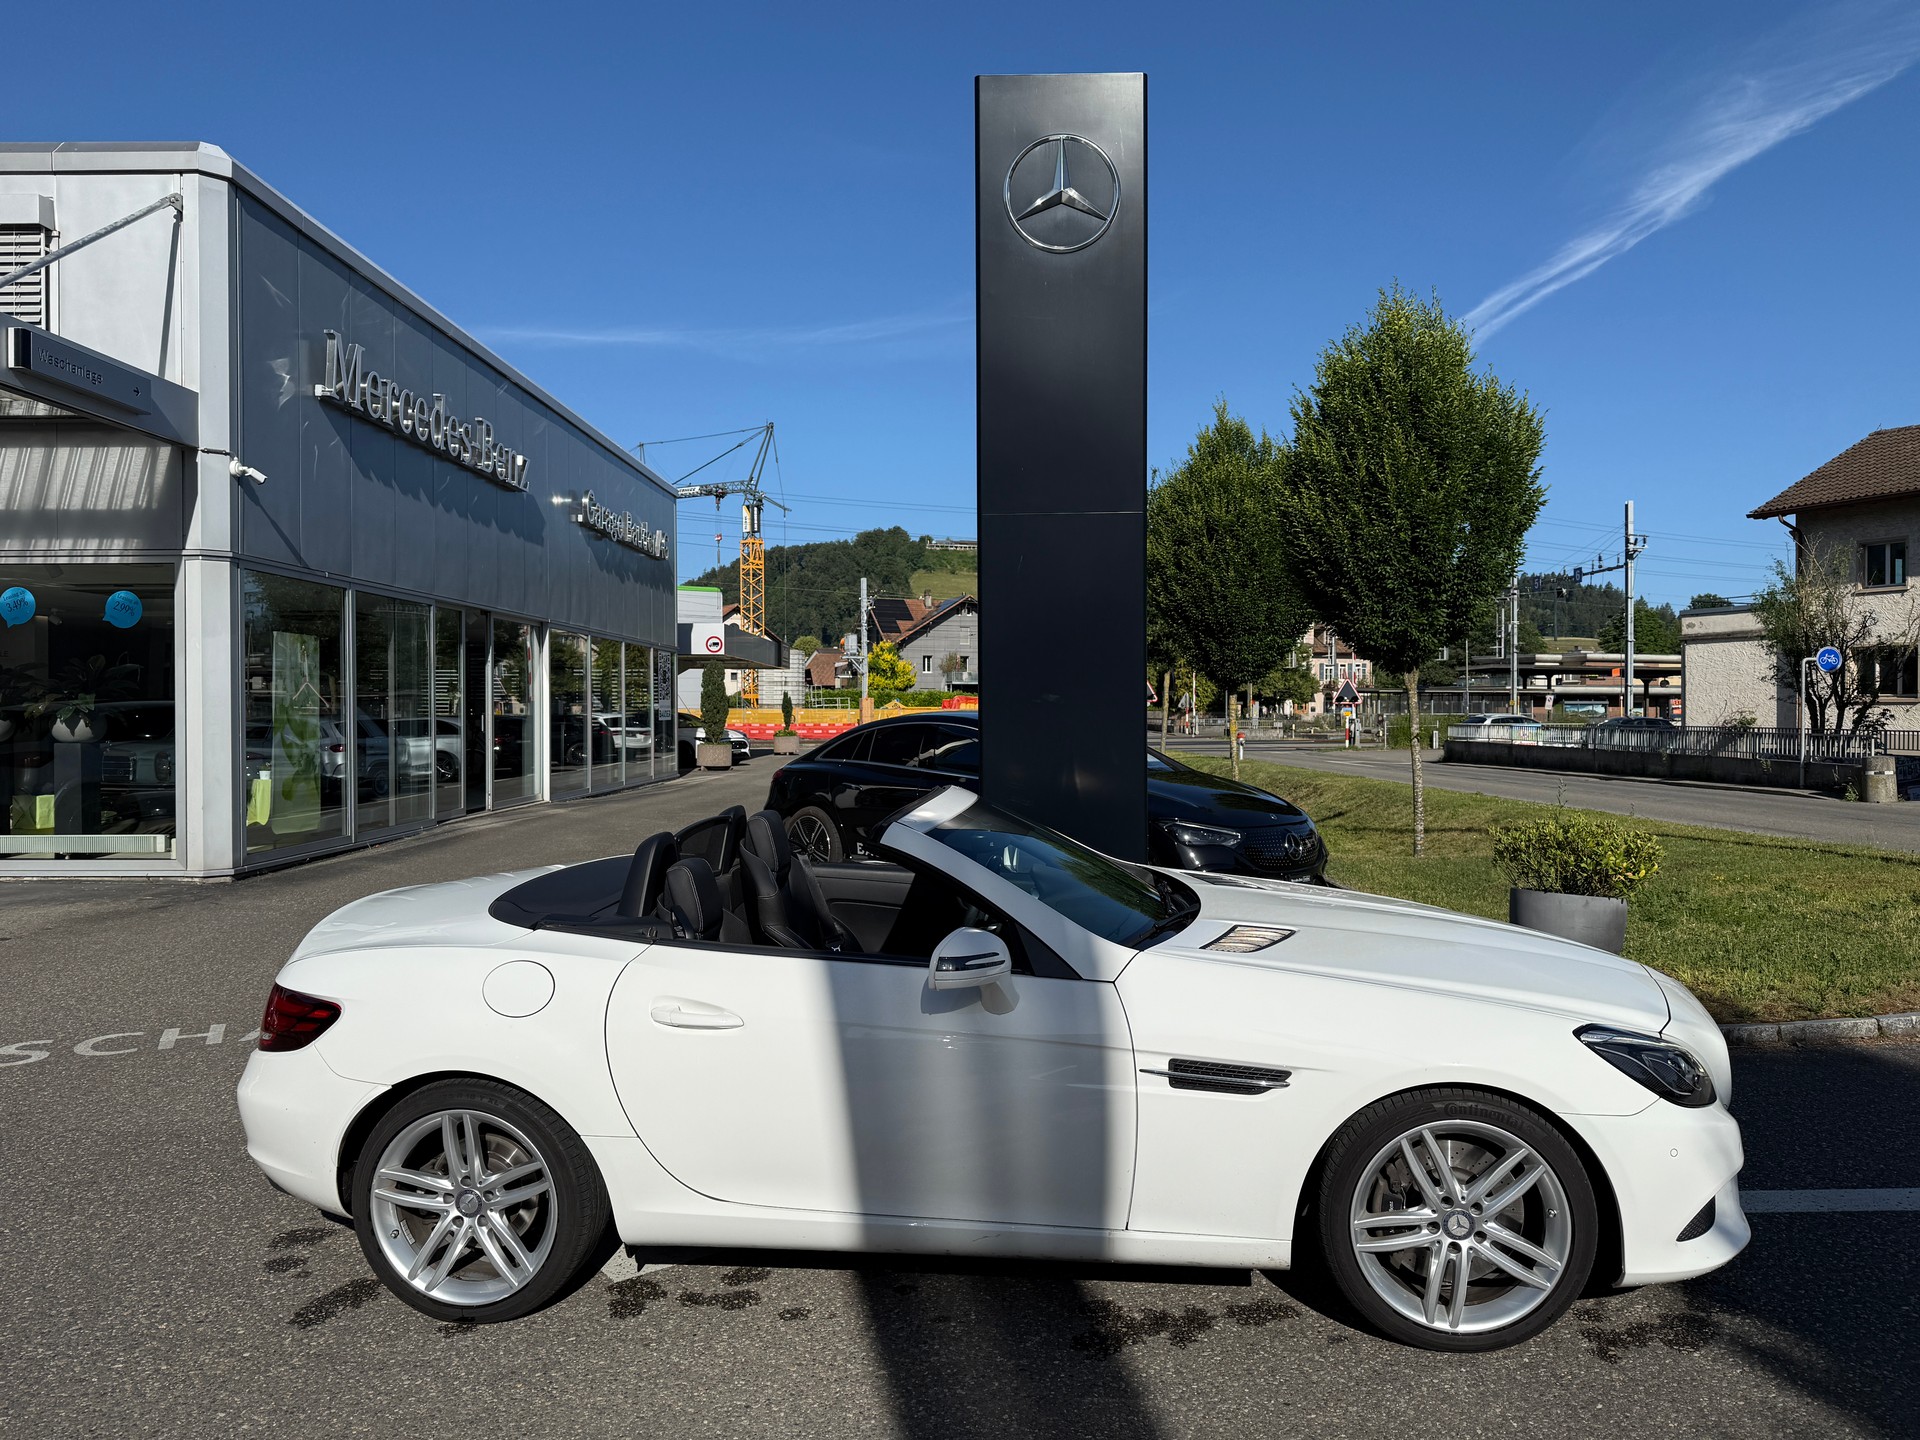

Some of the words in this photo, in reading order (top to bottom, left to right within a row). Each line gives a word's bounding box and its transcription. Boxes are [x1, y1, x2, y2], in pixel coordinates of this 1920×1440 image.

[37, 347, 104, 385] Waschanlage
[316, 329, 530, 492] Mercedes-Benz
[581, 489, 624, 541] Garage
[6, 597, 29, 612] 3.49%
[113, 600, 135, 617] 2.99%
[0, 1024, 261, 1067] SCH
[1443, 1102, 1526, 1132] Continental
